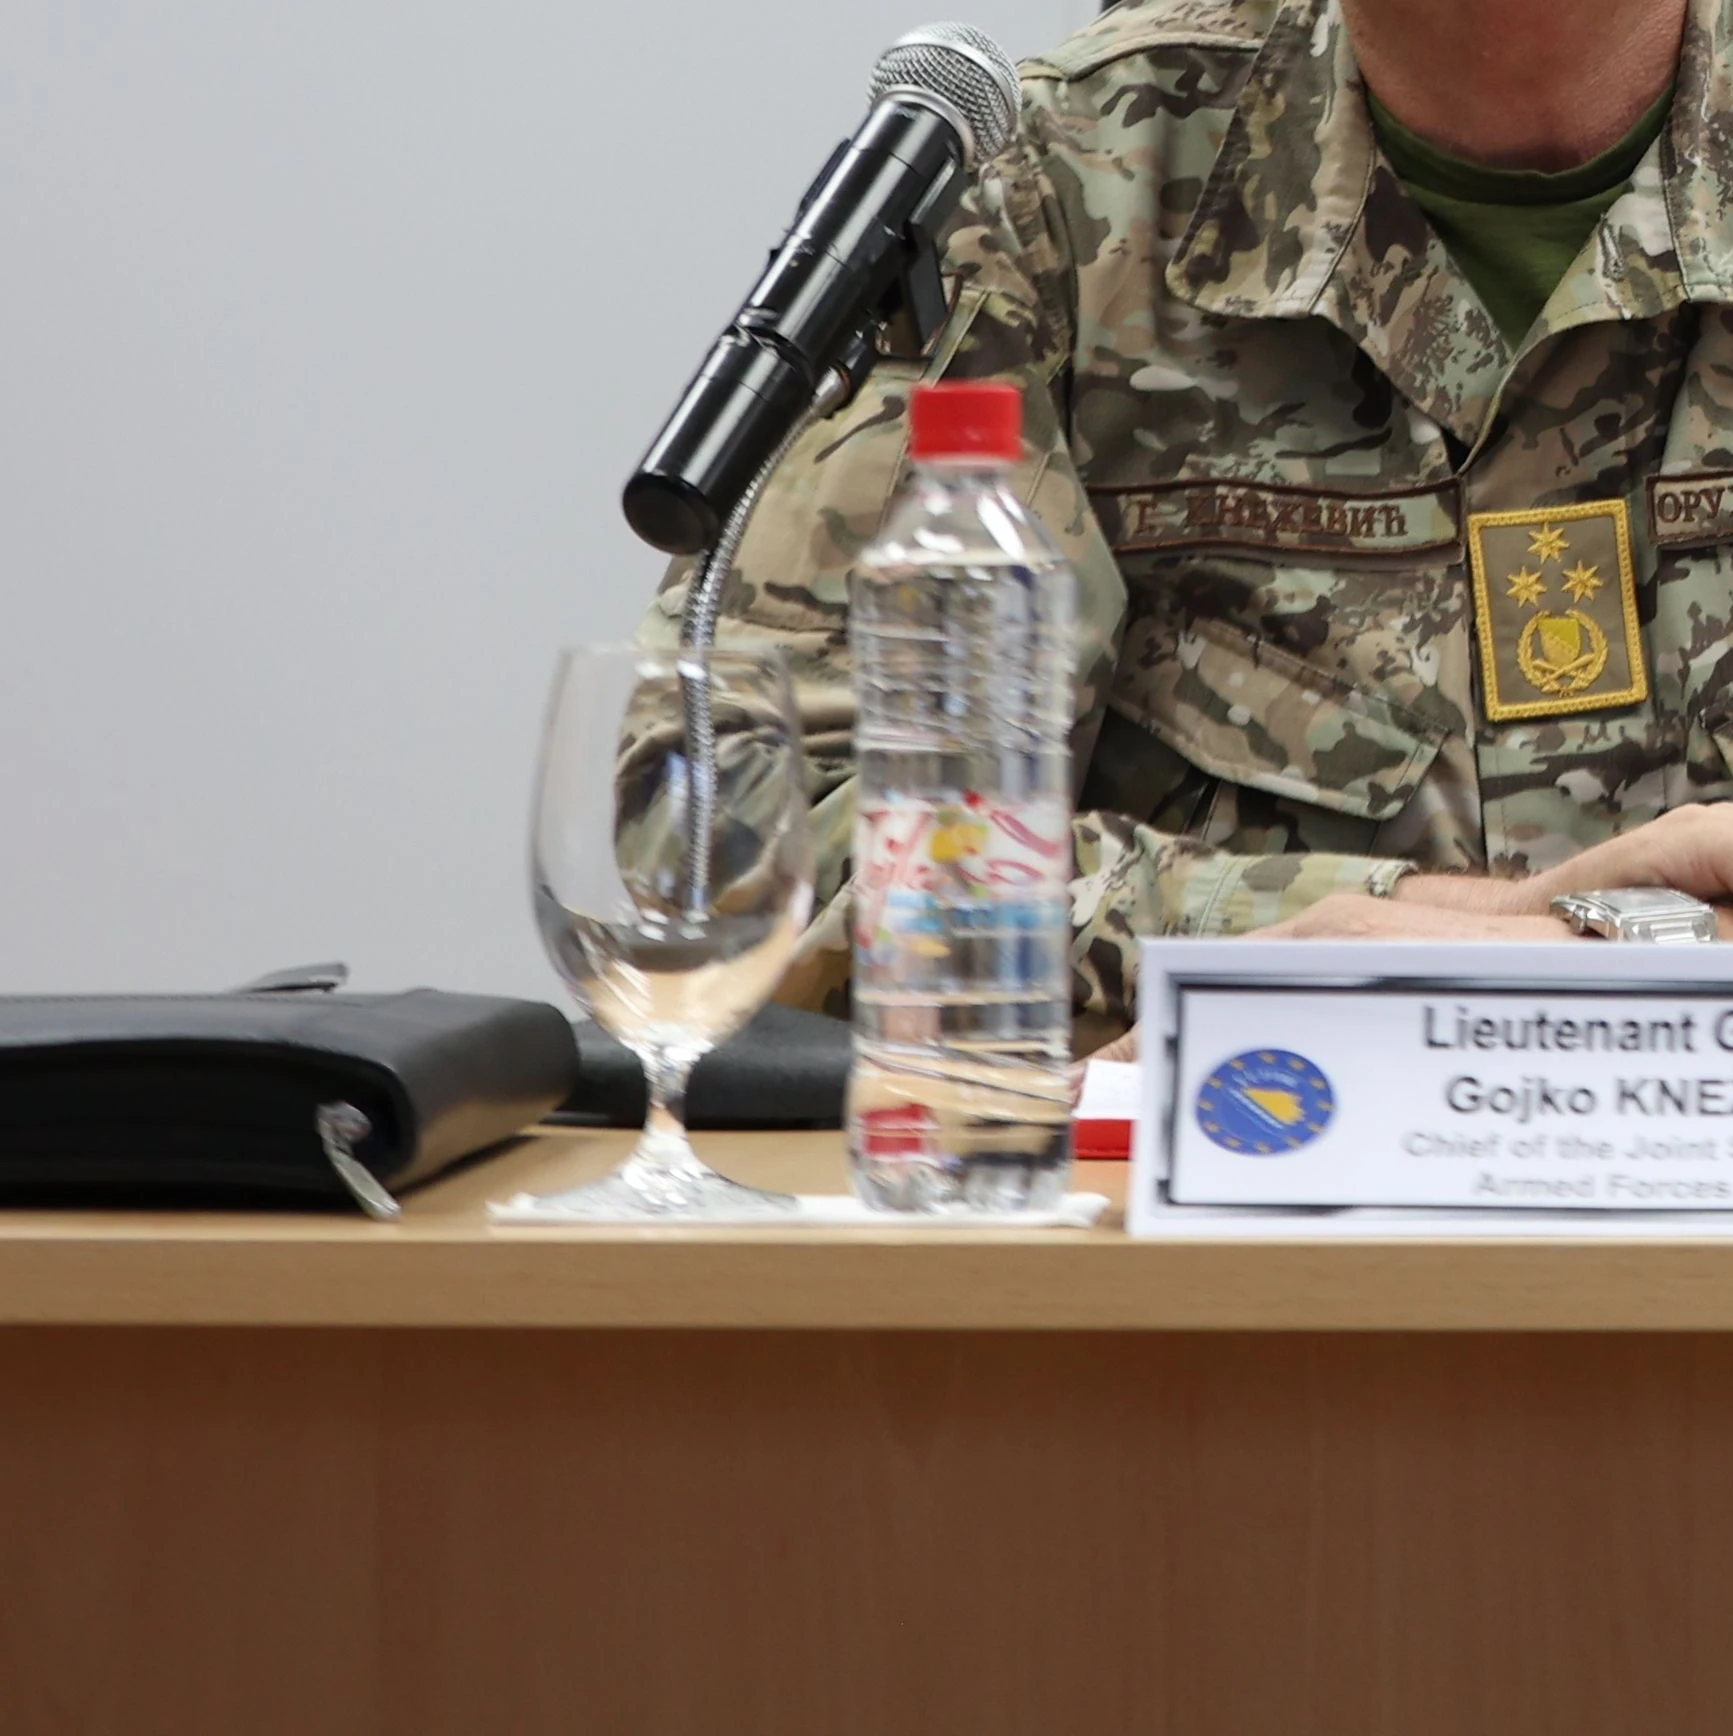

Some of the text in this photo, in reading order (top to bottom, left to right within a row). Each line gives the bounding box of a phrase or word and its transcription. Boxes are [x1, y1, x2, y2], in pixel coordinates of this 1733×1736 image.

[1423, 1006, 1697, 1053] Lieutenant
[1446, 1073, 1598, 1124] Gojko
[1401, 1131, 1501, 1160] Chief
[1509, 1132, 1547, 1160] of
[1558, 1133, 1614, 1161] the
[1624, 1135, 1718, 1163] Joint
[1473, 1171, 1595, 1200] Armed
[1607, 1173, 1732, 1201] Forces
